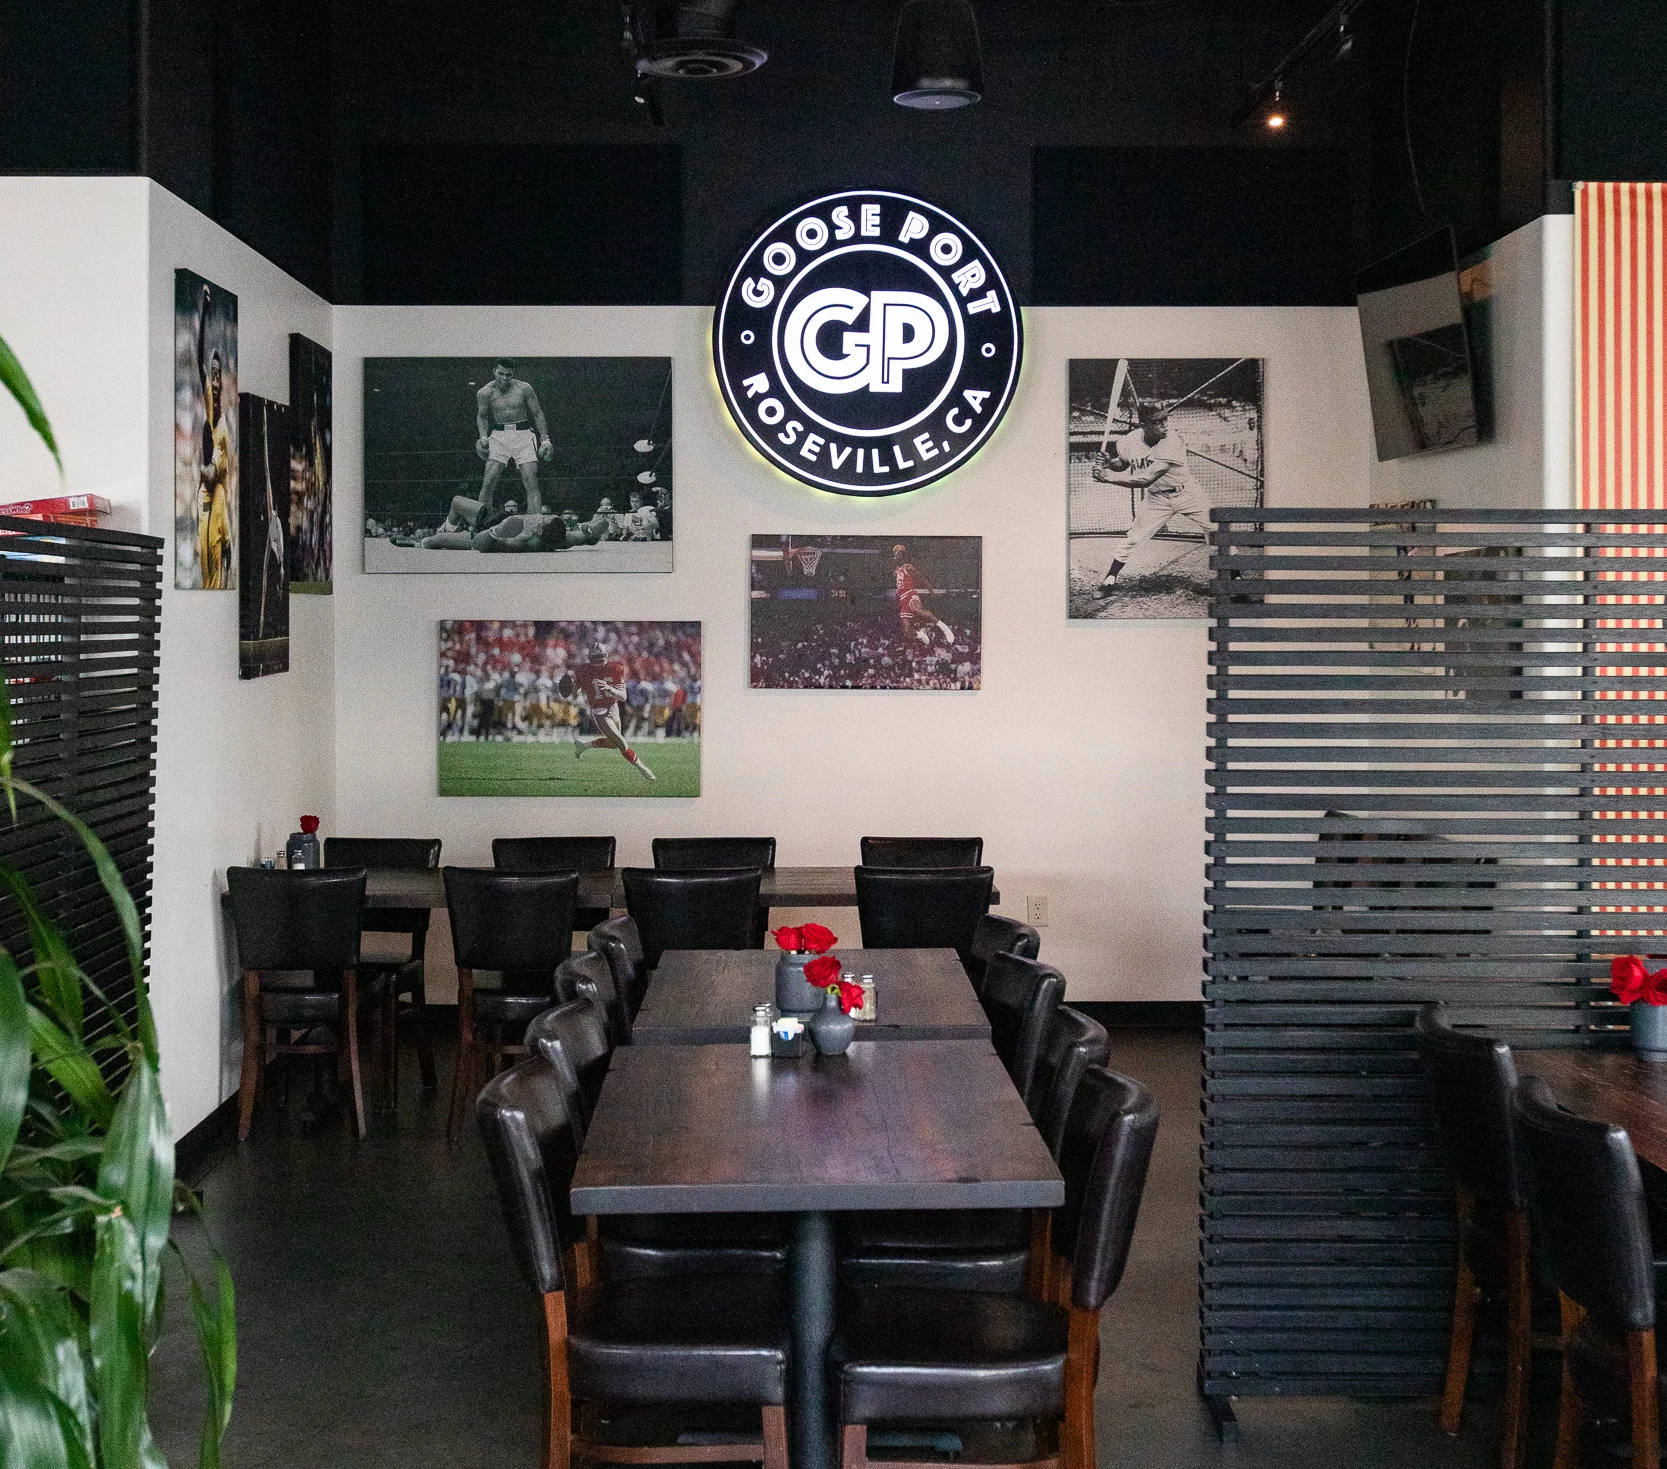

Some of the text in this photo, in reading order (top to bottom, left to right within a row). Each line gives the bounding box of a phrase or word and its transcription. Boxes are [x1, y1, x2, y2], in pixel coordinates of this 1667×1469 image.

[742, 204, 1001, 315] GOOSE PORT
[784, 287, 949, 394] GP
[743, 372, 991, 473] ROSEVILLE, CA
